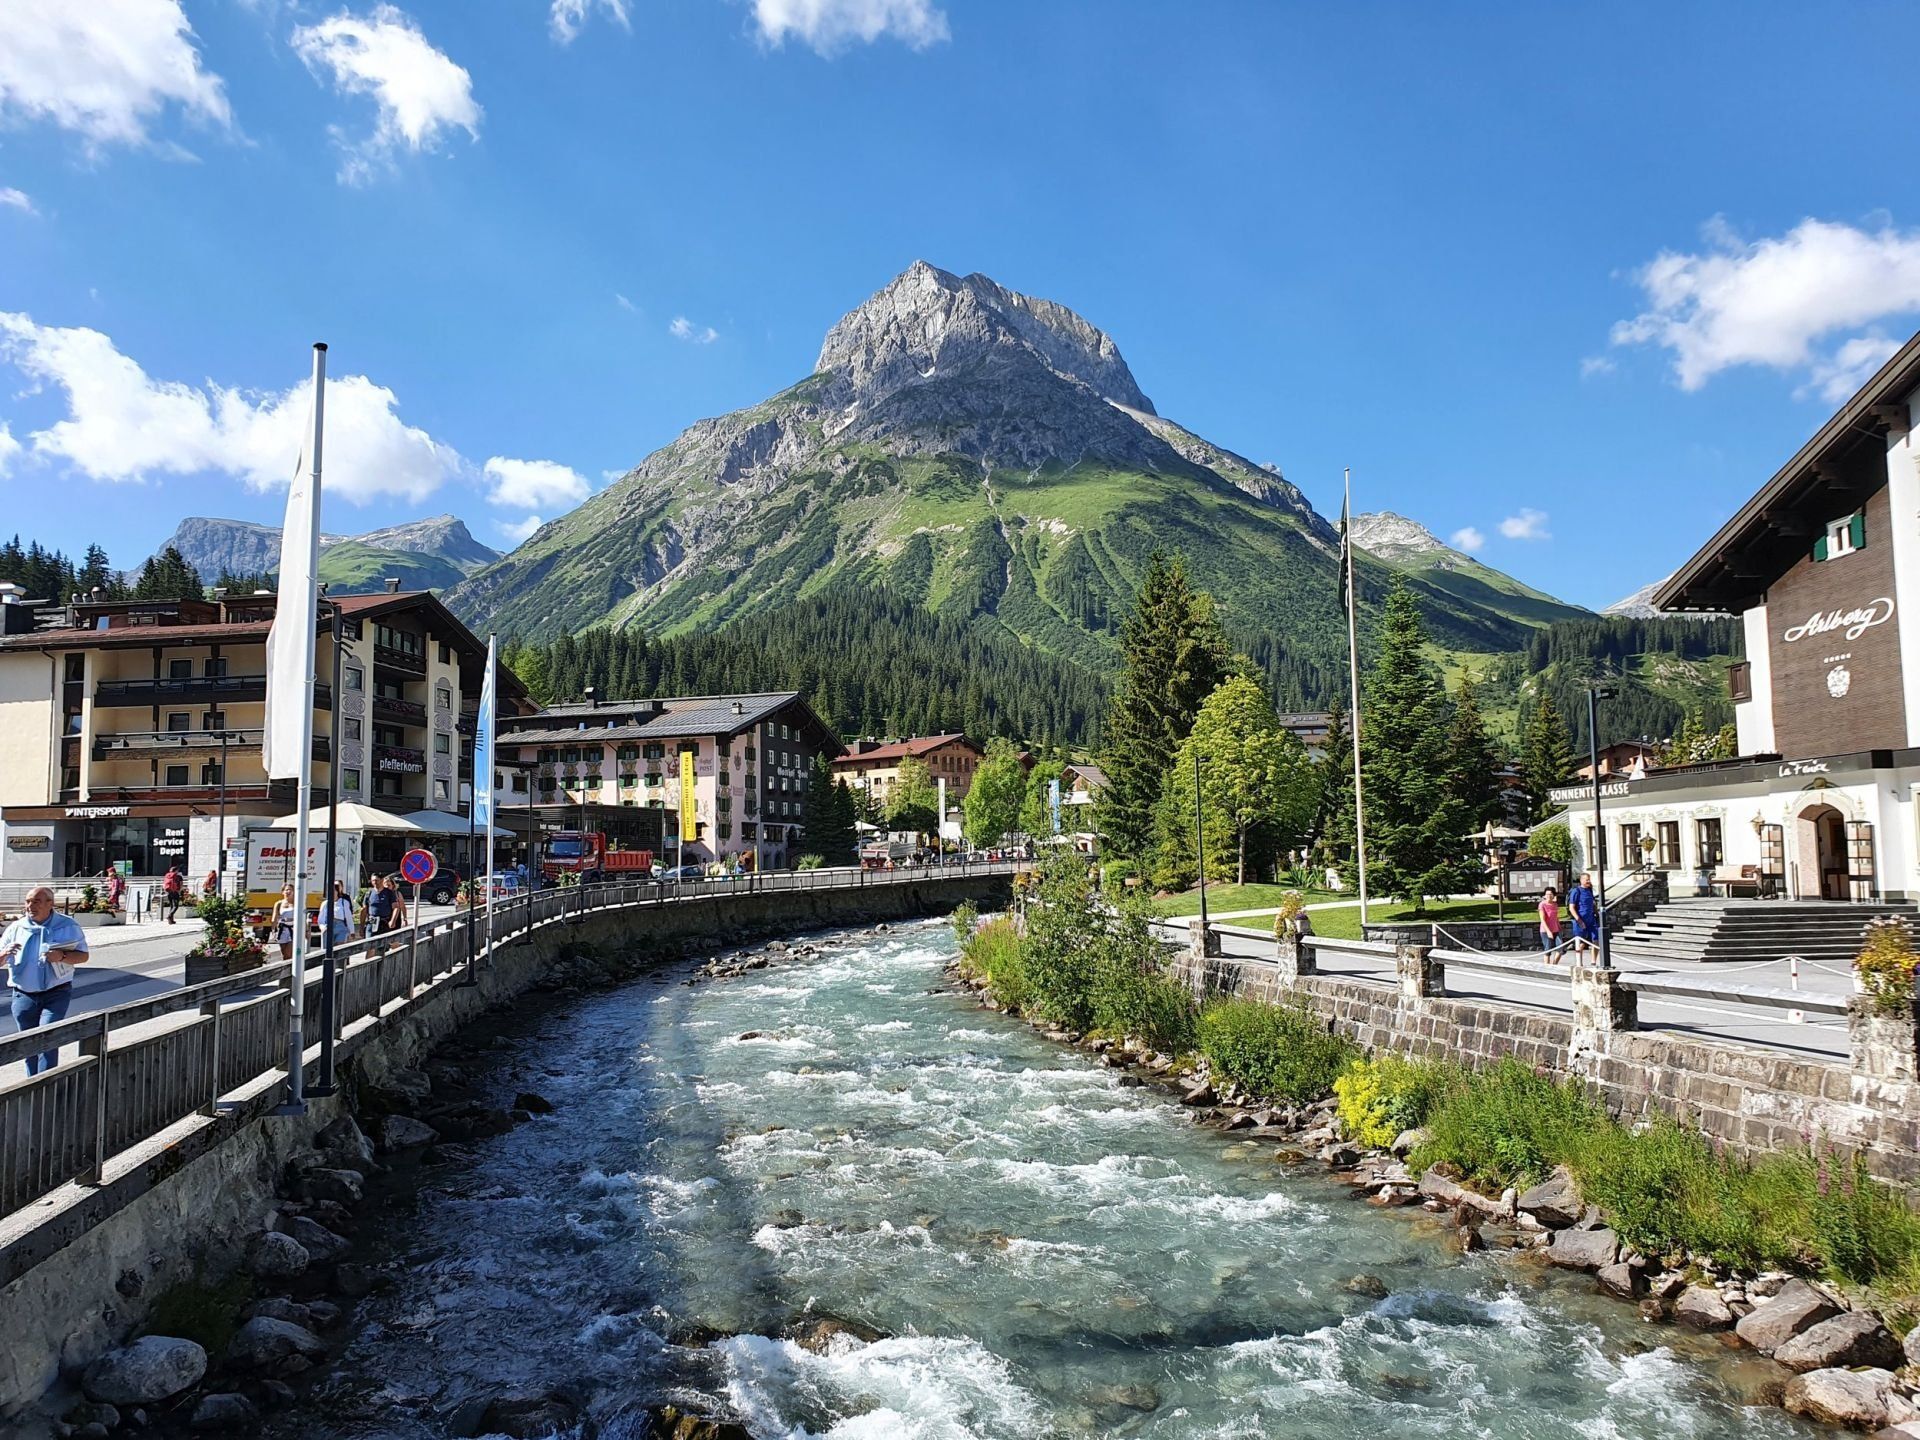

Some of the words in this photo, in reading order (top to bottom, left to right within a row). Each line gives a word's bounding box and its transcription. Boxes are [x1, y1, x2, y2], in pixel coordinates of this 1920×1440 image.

[1784, 597, 1895, 642] Arlberg
[1550, 782, 1629, 801] SONNENTERASSE
[73, 806, 129, 818] INTERSPORT
[165, 828, 184, 837] Rent
[153, 837, 184, 846] Service
[160, 847, 184, 857] Depot
[260, 847, 315, 857] Bischf
